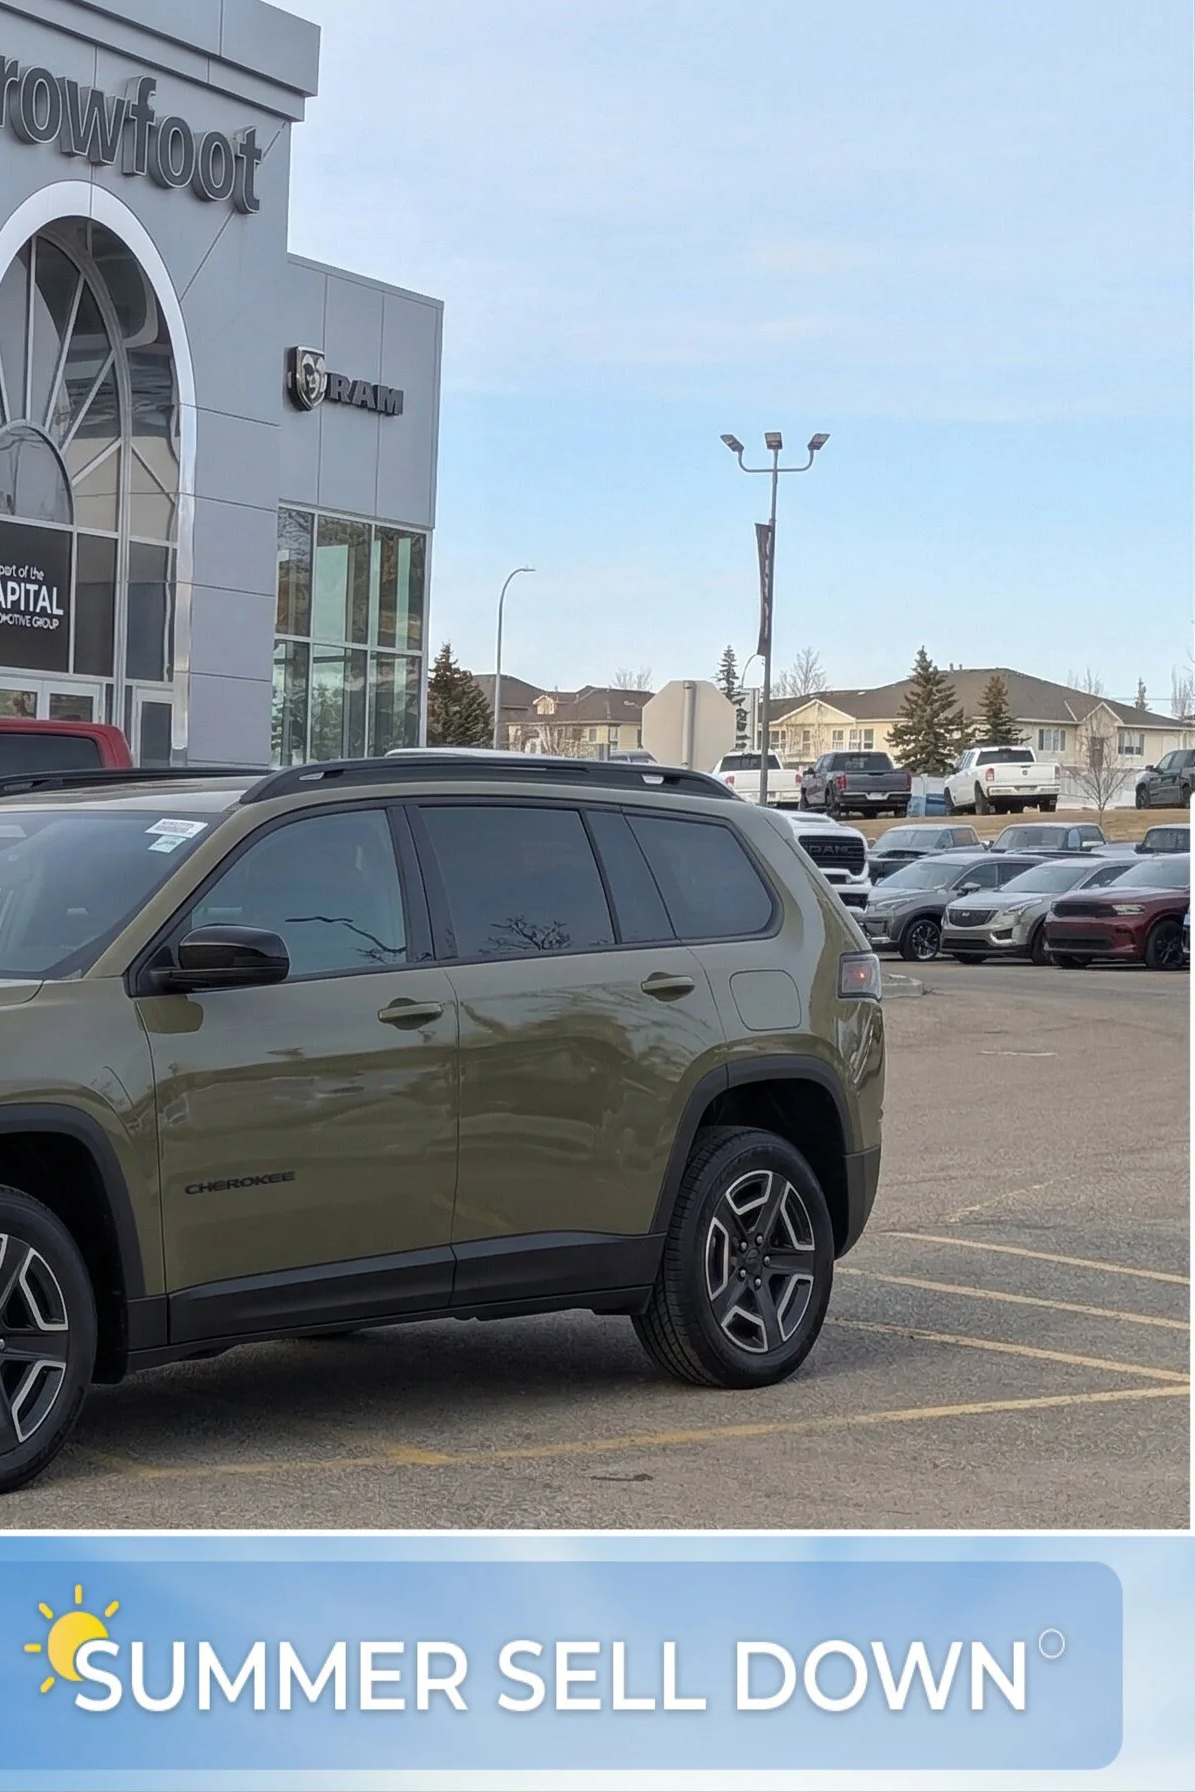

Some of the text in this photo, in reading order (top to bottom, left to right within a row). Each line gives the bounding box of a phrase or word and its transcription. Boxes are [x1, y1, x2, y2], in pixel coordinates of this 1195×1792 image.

[324, 372, 404, 416] RAM
[18, 565, 29, 578] of
[30, 566, 45, 581] the
[31, 616, 60, 630] GROUP
[184, 1170, 296, 1195] CHEROKEE
